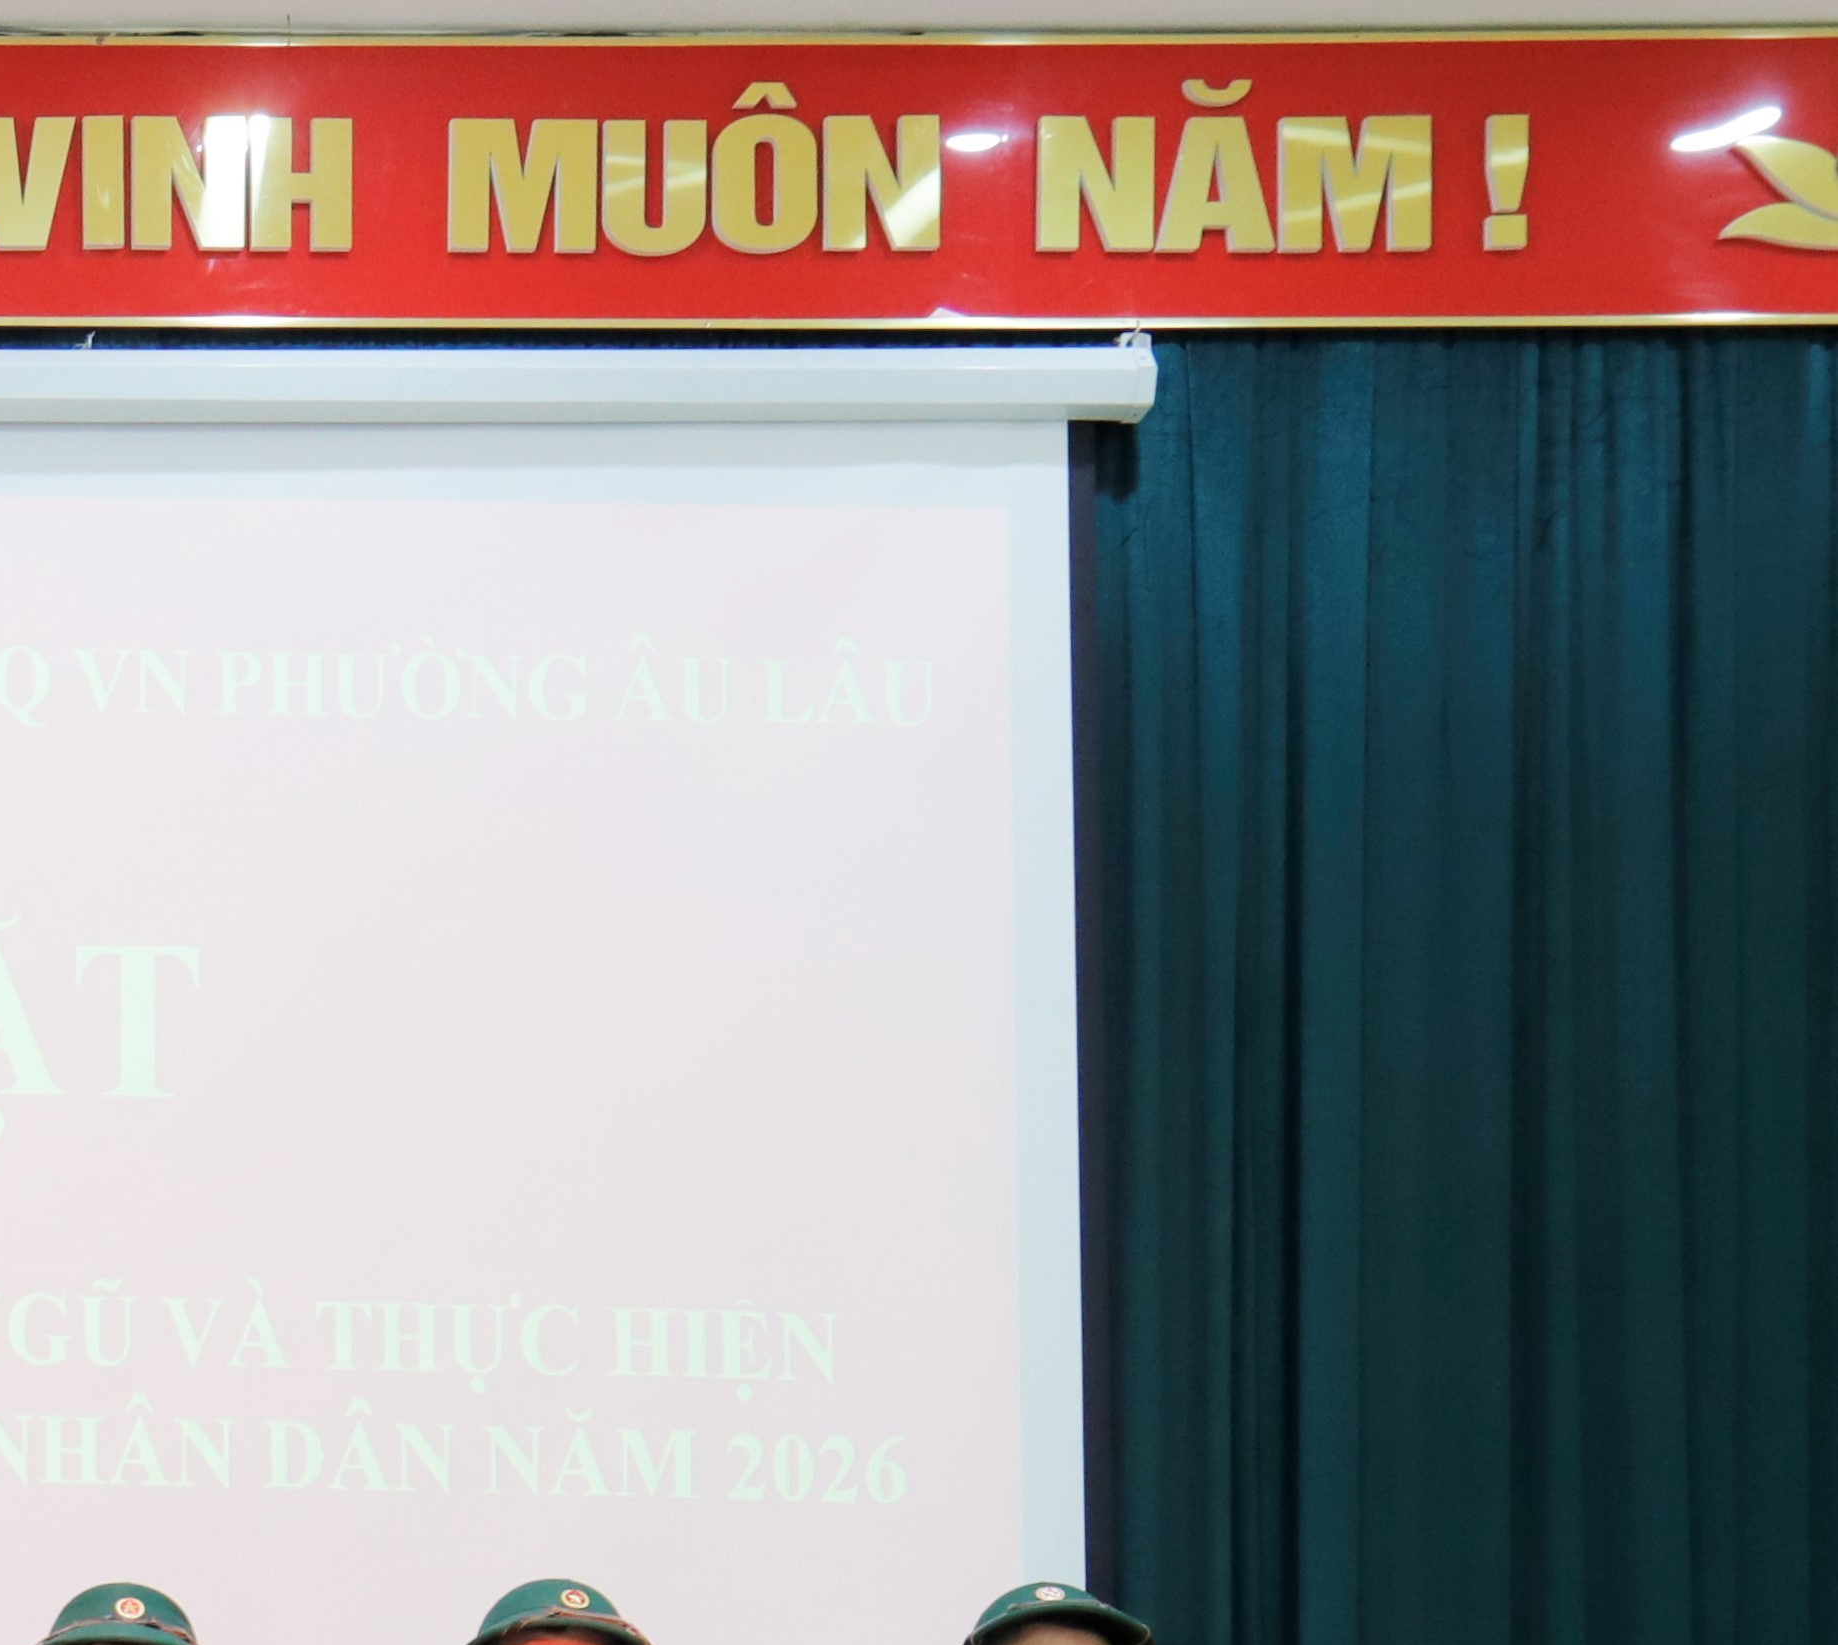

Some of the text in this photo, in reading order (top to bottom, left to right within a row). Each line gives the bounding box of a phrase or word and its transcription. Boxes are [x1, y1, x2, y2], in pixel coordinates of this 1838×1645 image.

[447, 81, 941, 256] MUÔN
[1036, 79, 1432, 254] NĂM
[74, 646, 189, 717] VN
[218, 635, 591, 723] PHƯỜNG
[616, 631, 735, 726] ÂU
[761, 635, 936, 729] LÂU
[163, 1281, 290, 1370] VÀ
[314, 1293, 581, 1394] THỰC
[611, 1297, 837, 1400] HIỆN
[261, 1402, 456, 1494] DÂN
[483, 1406, 698, 1502] NĂM
[726, 1431, 911, 1506] 2026
